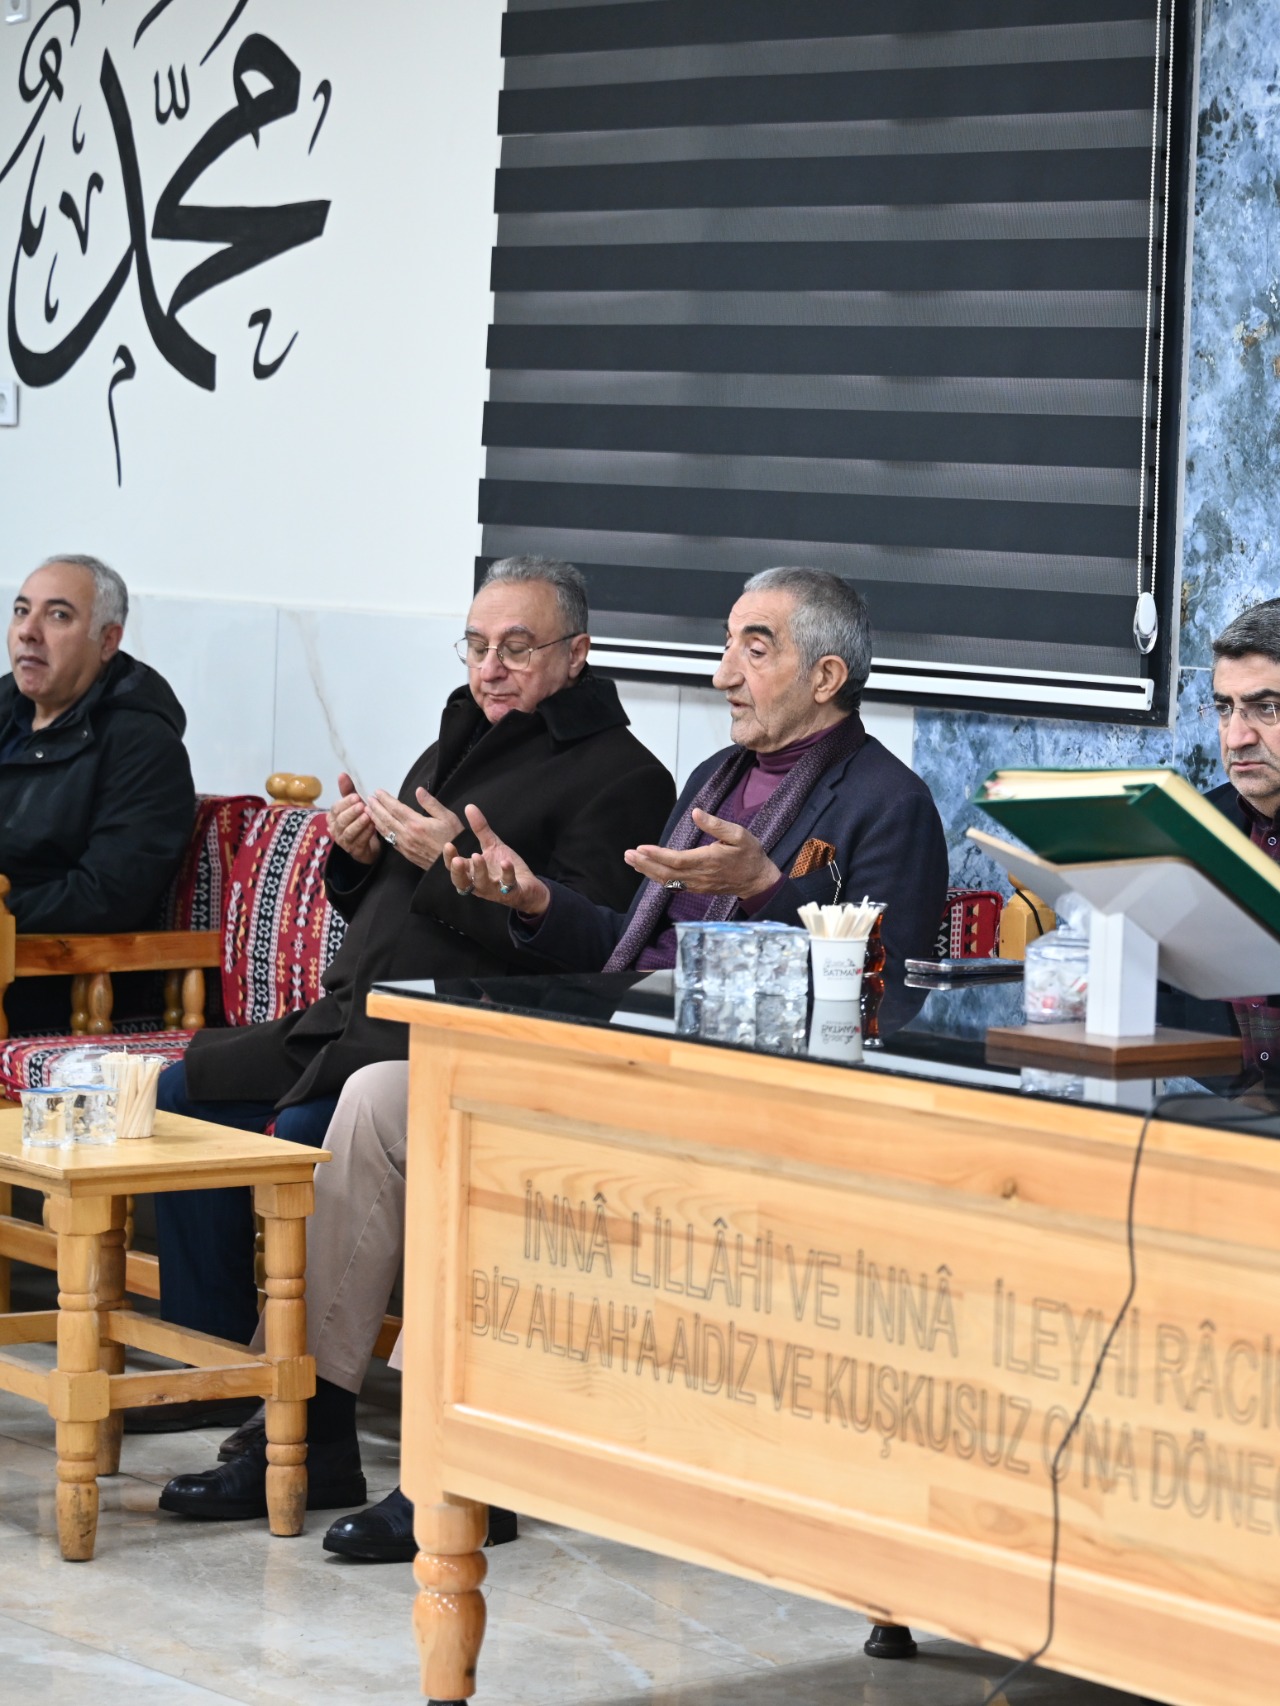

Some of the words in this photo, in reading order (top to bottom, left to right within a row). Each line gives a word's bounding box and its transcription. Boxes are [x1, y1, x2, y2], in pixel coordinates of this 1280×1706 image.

[471, 1266, 521, 1344] BİZ
[667, 1312, 760, 1405] AİDİZ
[766, 1338, 815, 1420] VE
[824, 1351, 1033, 1475] KUŞKUSUZ
[523, 1178, 613, 1278] İNNÂ
[631, 1206, 774, 1315] LİLLÂHİ
[785, 1244, 841, 1331] VE
[855, 1248, 959, 1358] İNNÂ
[992, 1277, 1142, 1399] İLEYHİ
